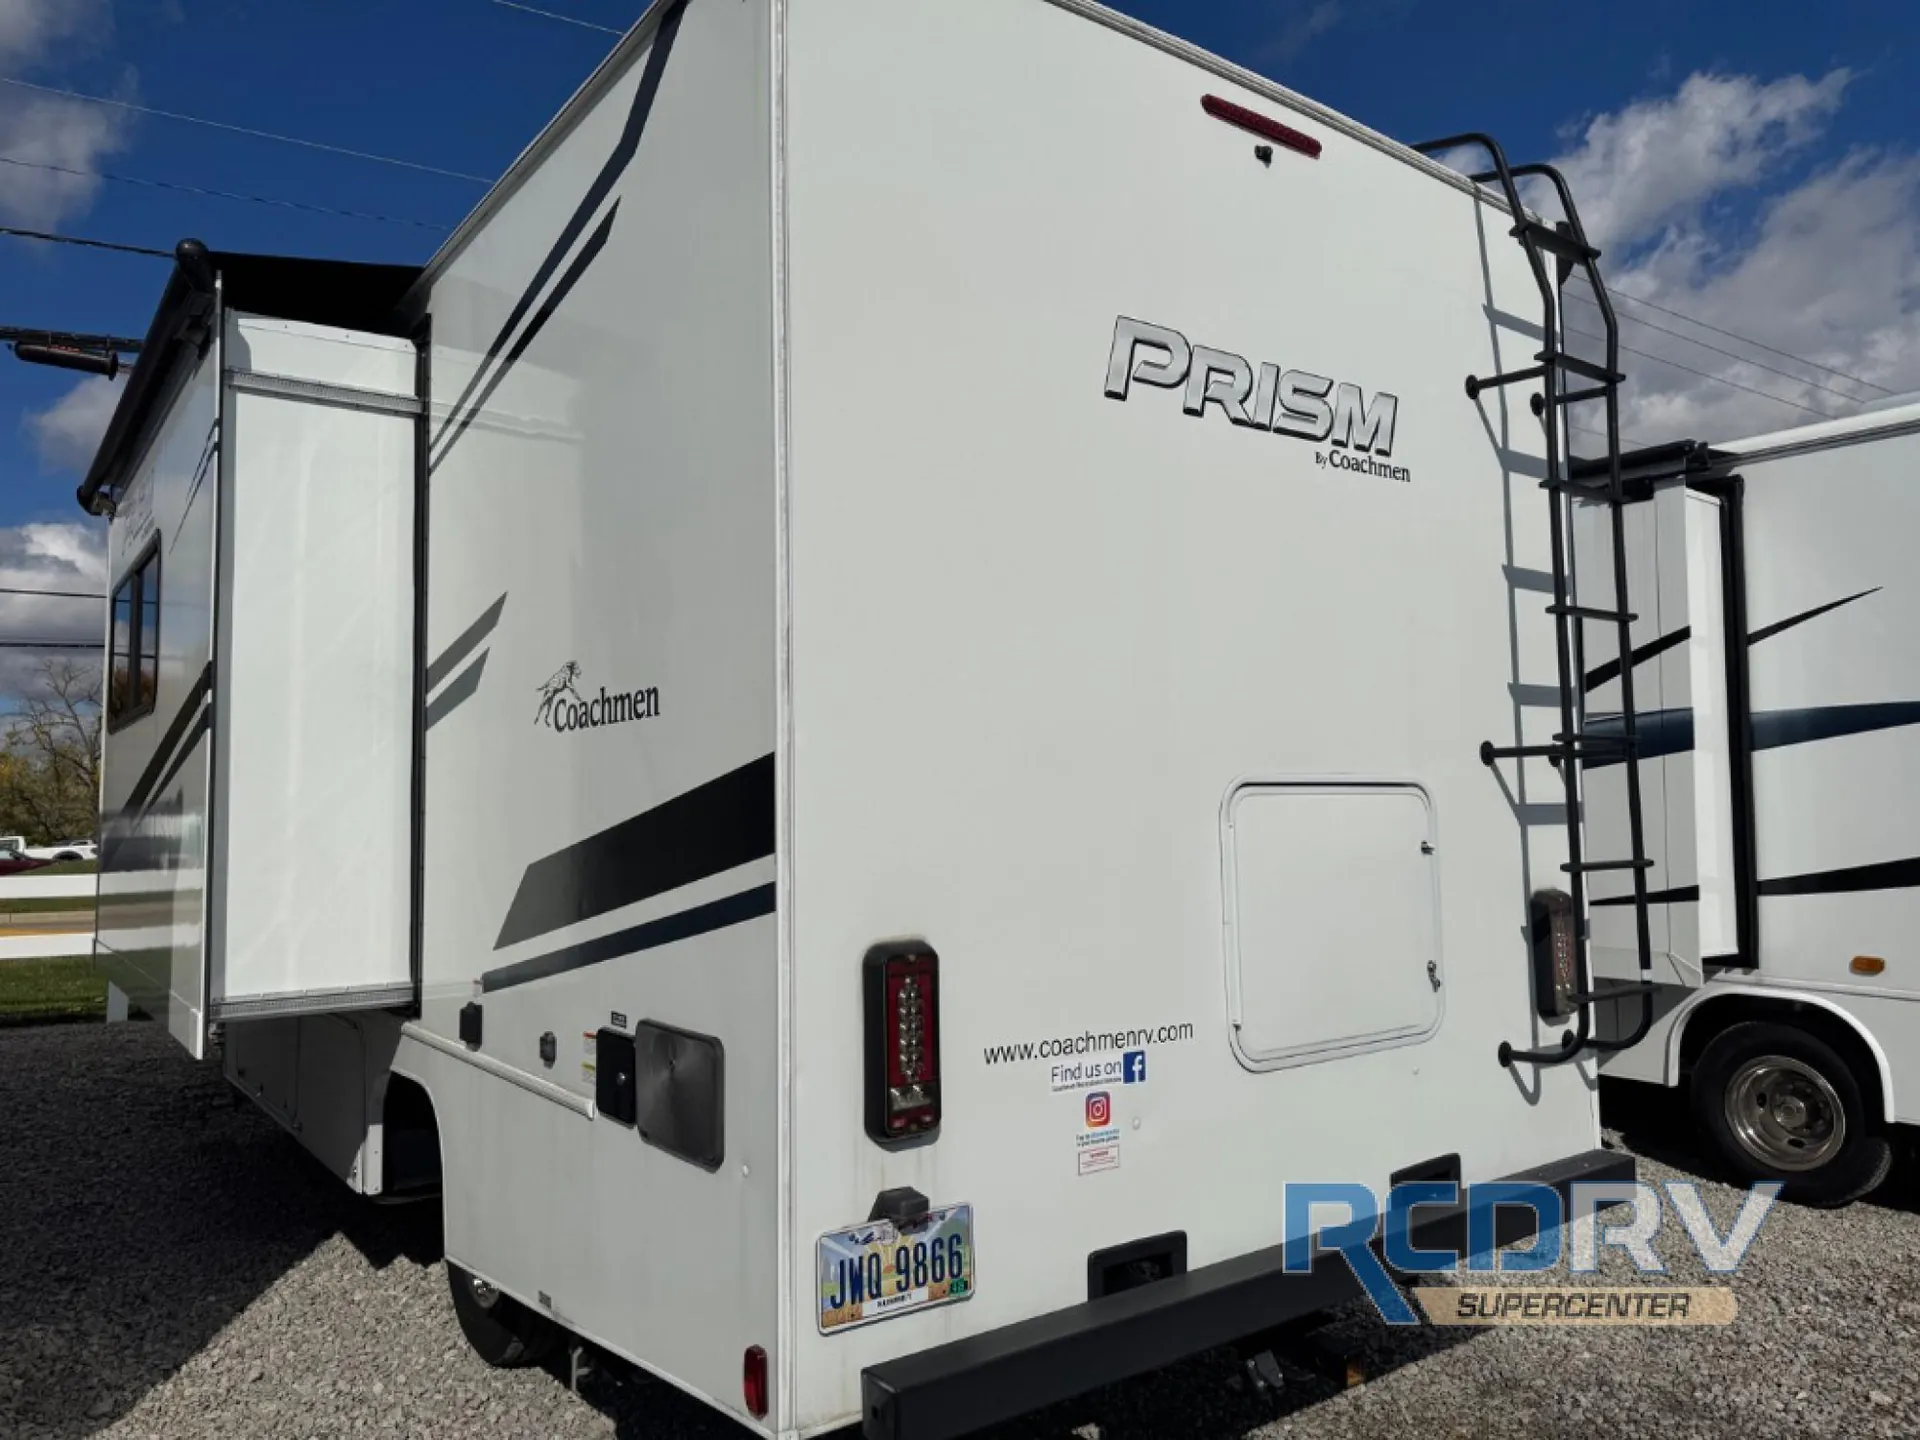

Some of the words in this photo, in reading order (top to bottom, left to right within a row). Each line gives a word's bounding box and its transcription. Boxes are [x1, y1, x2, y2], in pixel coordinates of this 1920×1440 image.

[1104, 315, 1398, 456] PRISM
[1315, 450, 1328, 469] By
[1329, 449, 1410, 482] Coachmen
[554, 686, 660, 733] Coachmen
[984, 1022, 1193, 1065] www.coachmenrv.com
[1051, 1061, 1082, 1083] Find
[1085, 1063, 1101, 1078] us
[1104, 1060, 1122, 1075] on
[895, 1233, 963, 1292] 9866
